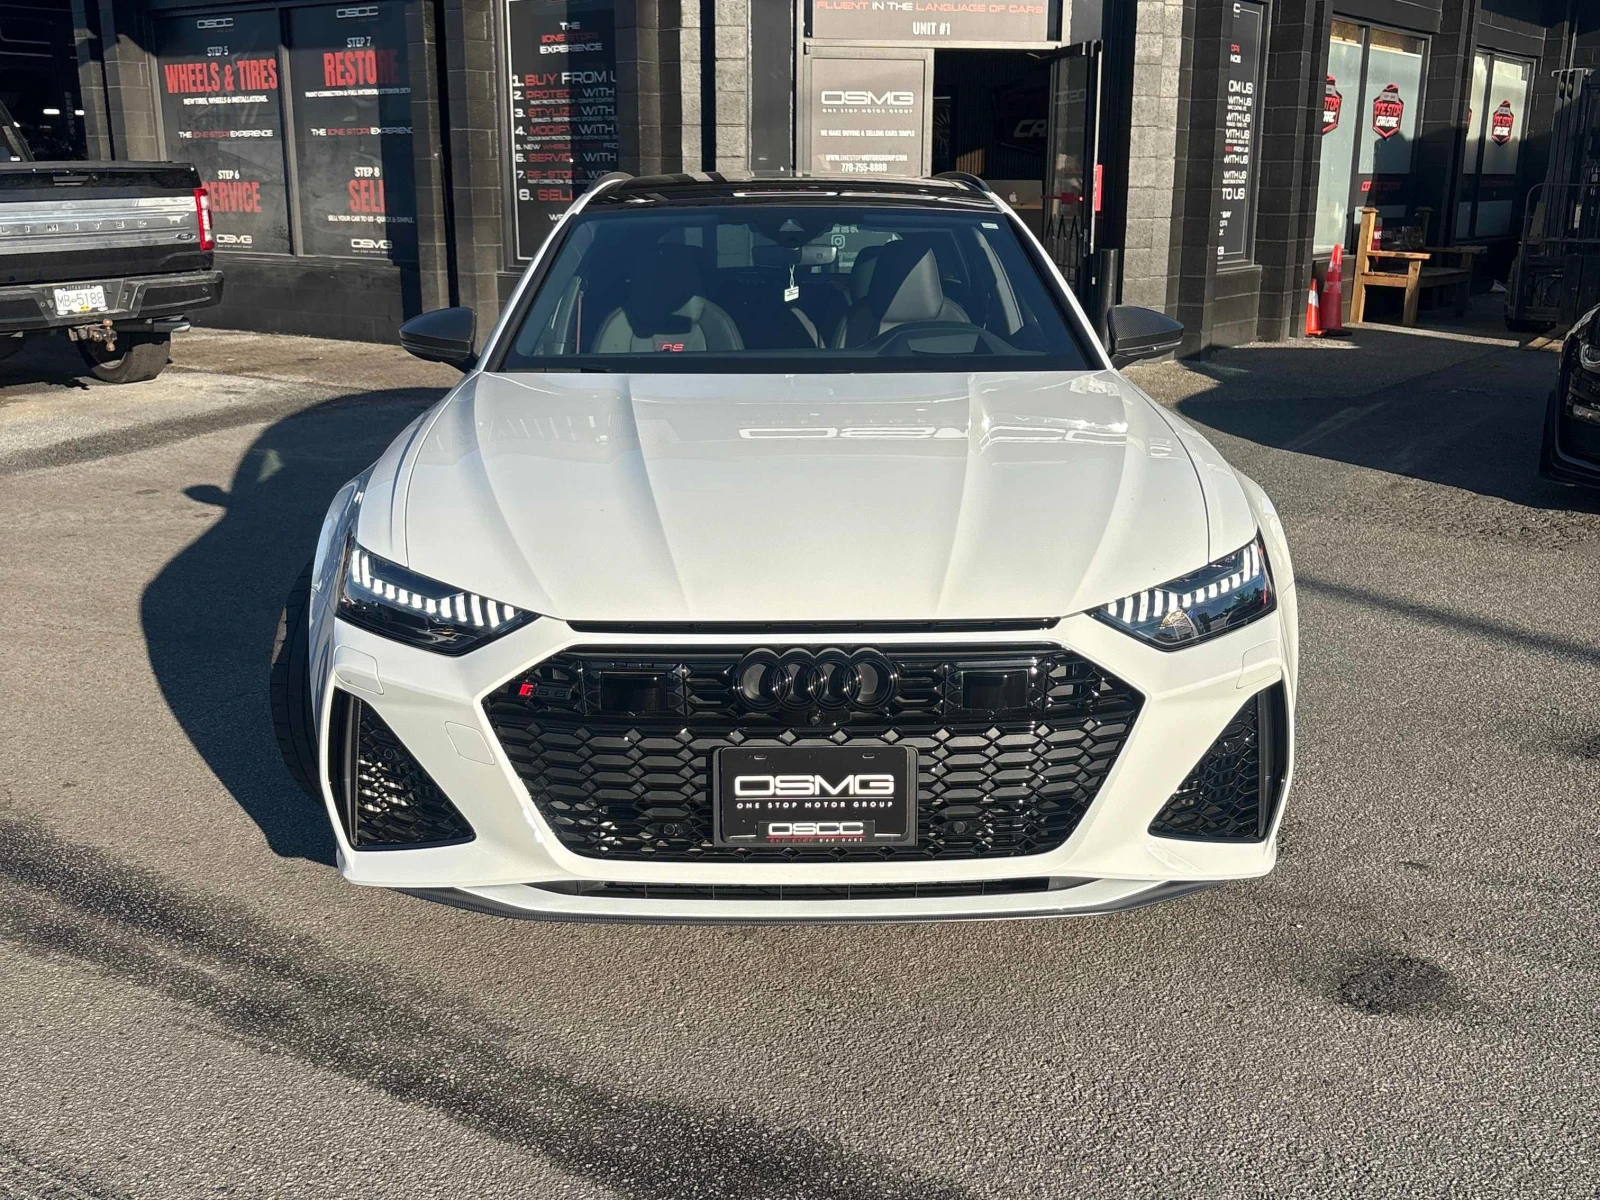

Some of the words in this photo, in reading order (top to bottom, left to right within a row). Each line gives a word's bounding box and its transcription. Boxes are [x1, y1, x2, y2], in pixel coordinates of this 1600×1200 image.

[817, 2, 868, 10] FLUENT
[872, 2, 884, 10] IN
[887, 2, 913, 11] THE
[916, 2, 986, 12] LANGUAGE
[989, 4, 1006, 12] OF
[1008, 4, 1044, 14] CARS
[559, 22, 581, 31] THE
[913, 22, 937, 35] UNIT
[939, 22, 950, 35] #1
[346, 37, 365, 48] STEP
[366, 36, 372, 47] 7
[207, 46, 223, 56] STEP
[223, 46, 229, 56] 5
[540, 43, 603, 54] EXPERIENCE
[164, 62, 220, 94] WHEELS
[224, 64, 235, 91] &
[237, 58, 278, 90] TIRES
[525, 73, 558, 87] BUY
[561, 70, 607, 85] FROM
[582, 88, 616, 97] WITH
[1242, 82, 1253, 94] US
[821, 91, 914, 105] OSMG
[1243, 97, 1252, 106] US
[581, 105, 614, 116] WITH
[1242, 113, 1251, 123] US
[230, 129, 273, 138] EXPERIENCE
[310, 128, 326, 136] THE
[515, 126, 527, 135] 4.
[579, 124, 614, 134] WITH
[1241, 130, 1250, 139] US
[515, 154, 527, 162] 6.
[583, 152, 617, 162] WITH
[1240, 155, 1248, 164] US
[218, 170, 234, 179] STEP
[234, 170, 240, 179] 6
[354, 166, 374, 178] STEP
[374, 167, 381, 177] 8
[516, 170, 526, 179] 7.
[1239, 171, 1247, 179] US
[519, 189, 533, 200] 8.
[1233, 188, 1245, 200] US
[216, 234, 252, 244] OSMG
[351, 239, 393, 250] OSMG
[734, 775, 894, 796] OSMG
[768, 801, 798, 809] STOP
[768, 822, 864, 836] OSCC
